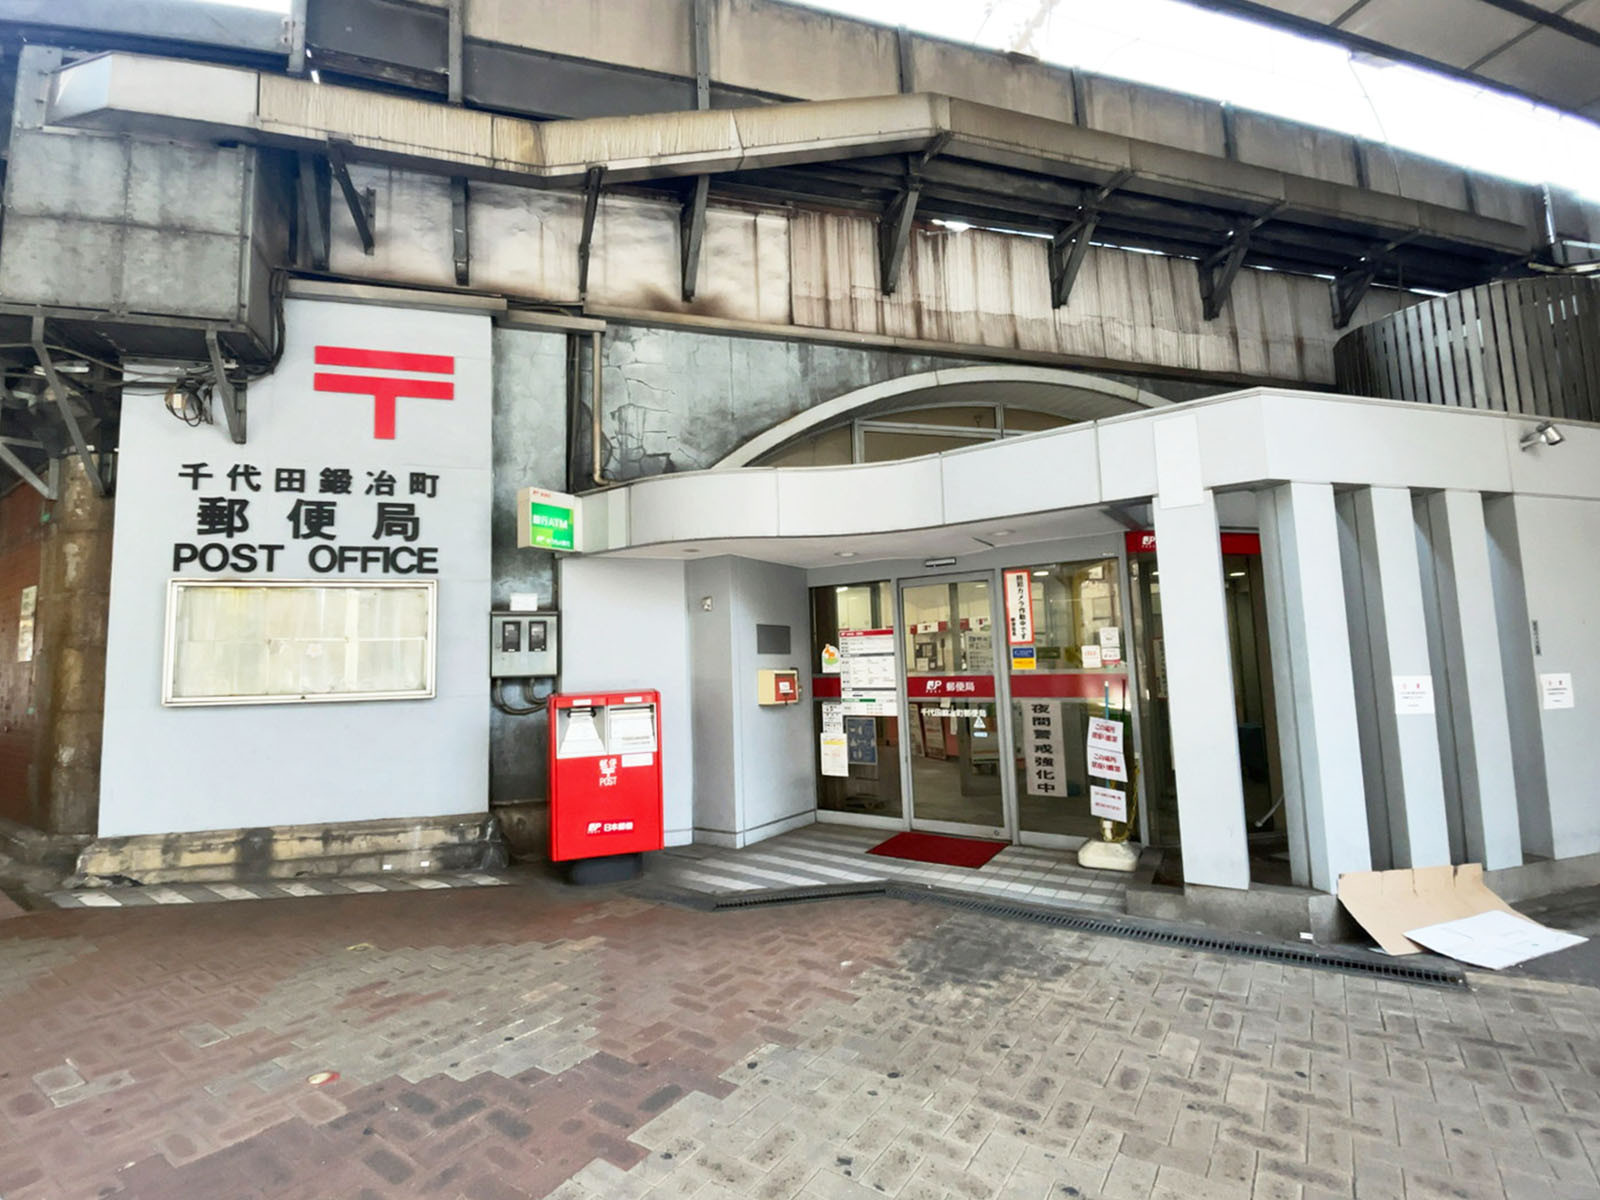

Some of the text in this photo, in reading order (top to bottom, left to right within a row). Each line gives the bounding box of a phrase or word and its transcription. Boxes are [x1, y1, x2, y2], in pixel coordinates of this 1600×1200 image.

[178, 462, 440, 498] 千代田鍛冶町
[196, 496, 420, 542] 郵便局
[173, 542, 439, 574] POST OFFICE
[599, 776, 617, 787] POST
